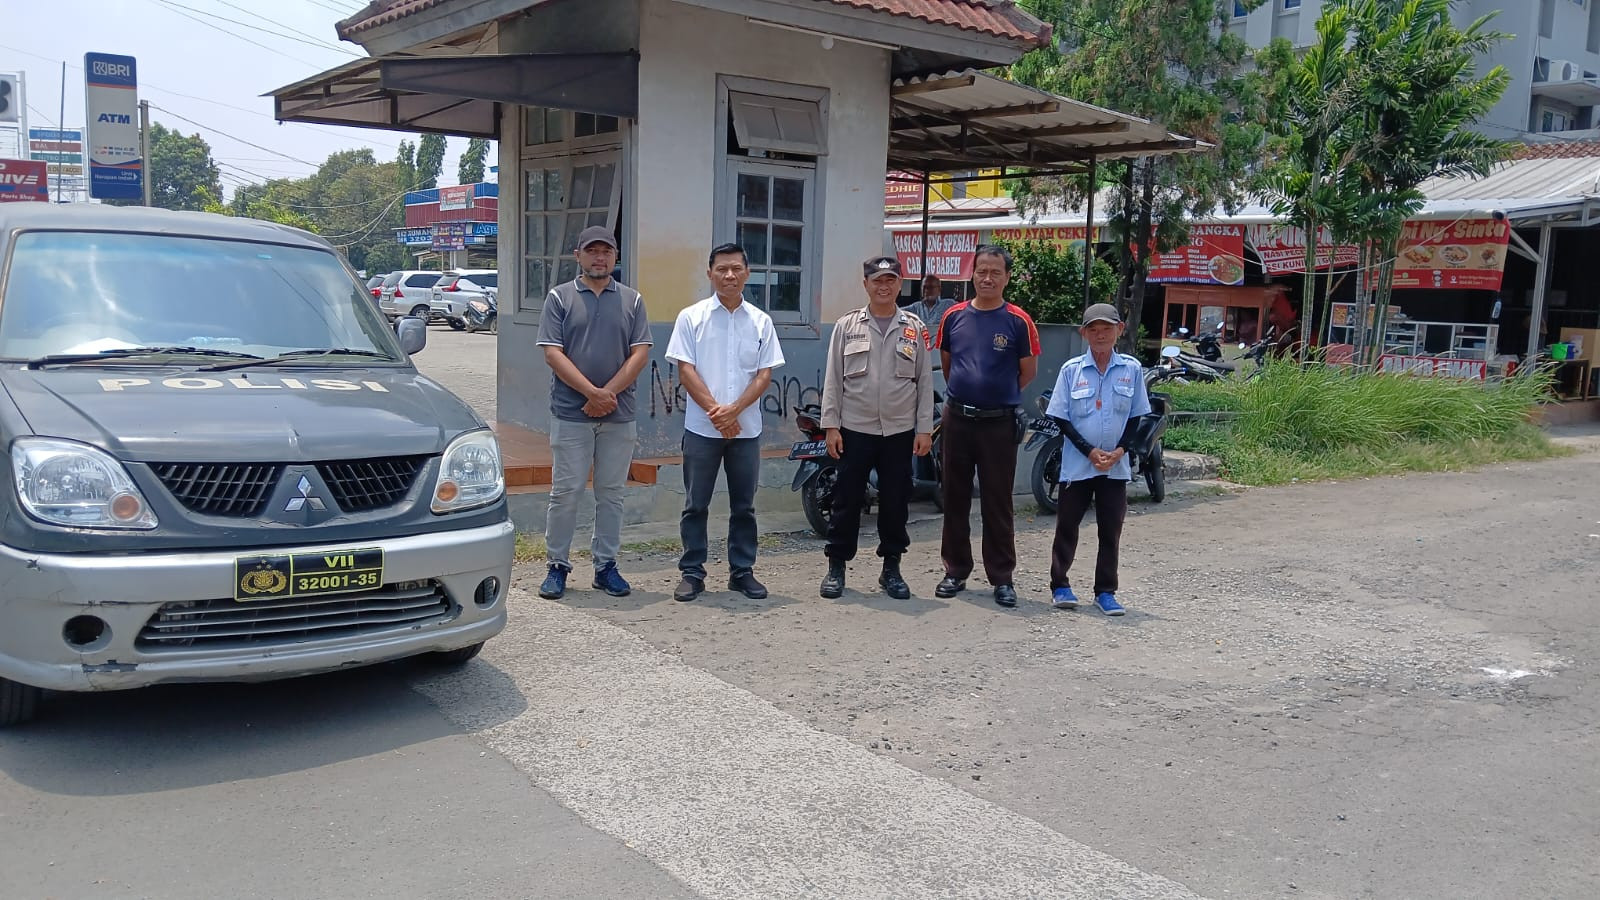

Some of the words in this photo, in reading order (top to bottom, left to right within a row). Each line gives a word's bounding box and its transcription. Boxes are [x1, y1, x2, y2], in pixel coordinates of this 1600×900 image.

[107, 63, 131, 77] BRI
[97, 113, 131, 125] ATM
[1025, 228, 1055, 241] AYAM
[1188, 225, 1241, 237] BANGKA
[1453, 218, 1506, 239] Sinta
[911, 234, 942, 252] GOENG
[943, 233, 977, 253] SPESIAL
[906, 256, 935, 274] CABNG
[936, 256, 961, 276] BABEH
[97, 378, 389, 392] POLISI
[324, 554, 354, 568] VII
[299, 573, 377, 591] 32001-35
